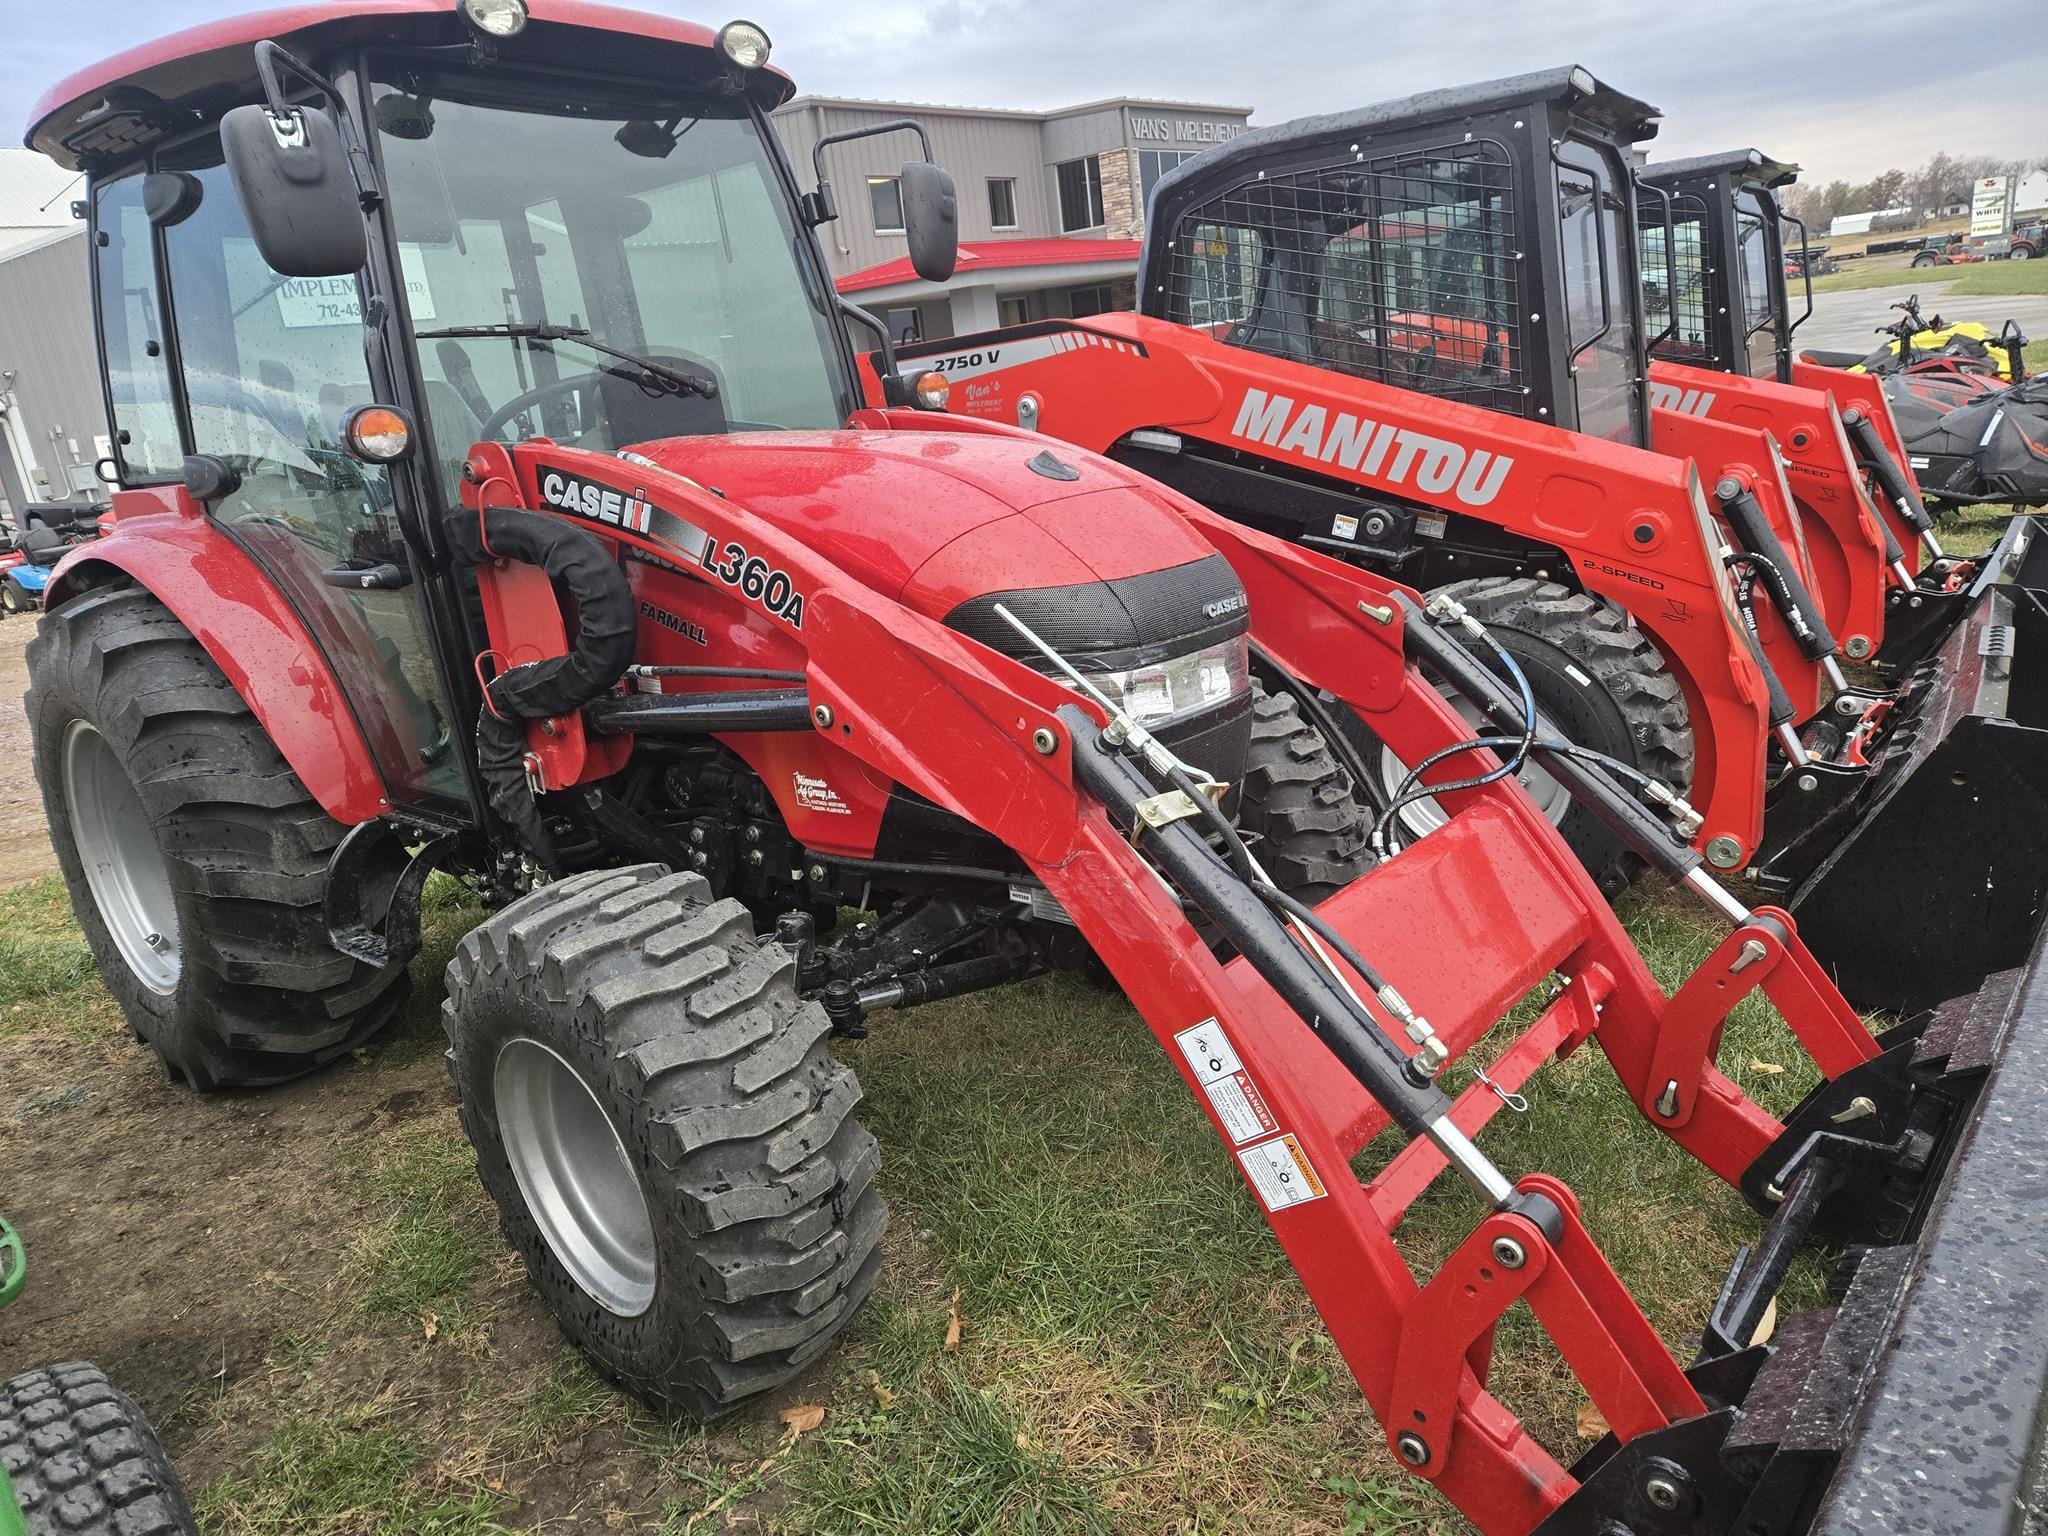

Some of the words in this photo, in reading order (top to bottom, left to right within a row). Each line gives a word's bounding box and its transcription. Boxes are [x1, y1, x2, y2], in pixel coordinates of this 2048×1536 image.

[1130, 118, 1169, 140] VAN'S
[1175, 120, 1241, 143] IMPLEMENT
[1975, 207, 2002, 216] WHITE
[281, 278, 358, 298] IMPLEM
[317, 304, 361, 318] 712-43
[934, 354, 983, 372] 2750
[987, 350, 1001, 363] V
[965, 380, 1002, 401] Van's
[1231, 387, 1514, 506] MANITOU
[1790, 466, 1830, 478] PEED
[700, 535, 805, 631] L360A
[1583, 559, 1665, 591] 2-SPEED
[639, 600, 708, 647] FARMALL
[1243, 1086, 1271, 1128] DANGER
[1294, 1151, 1319, 1191] WARNING
